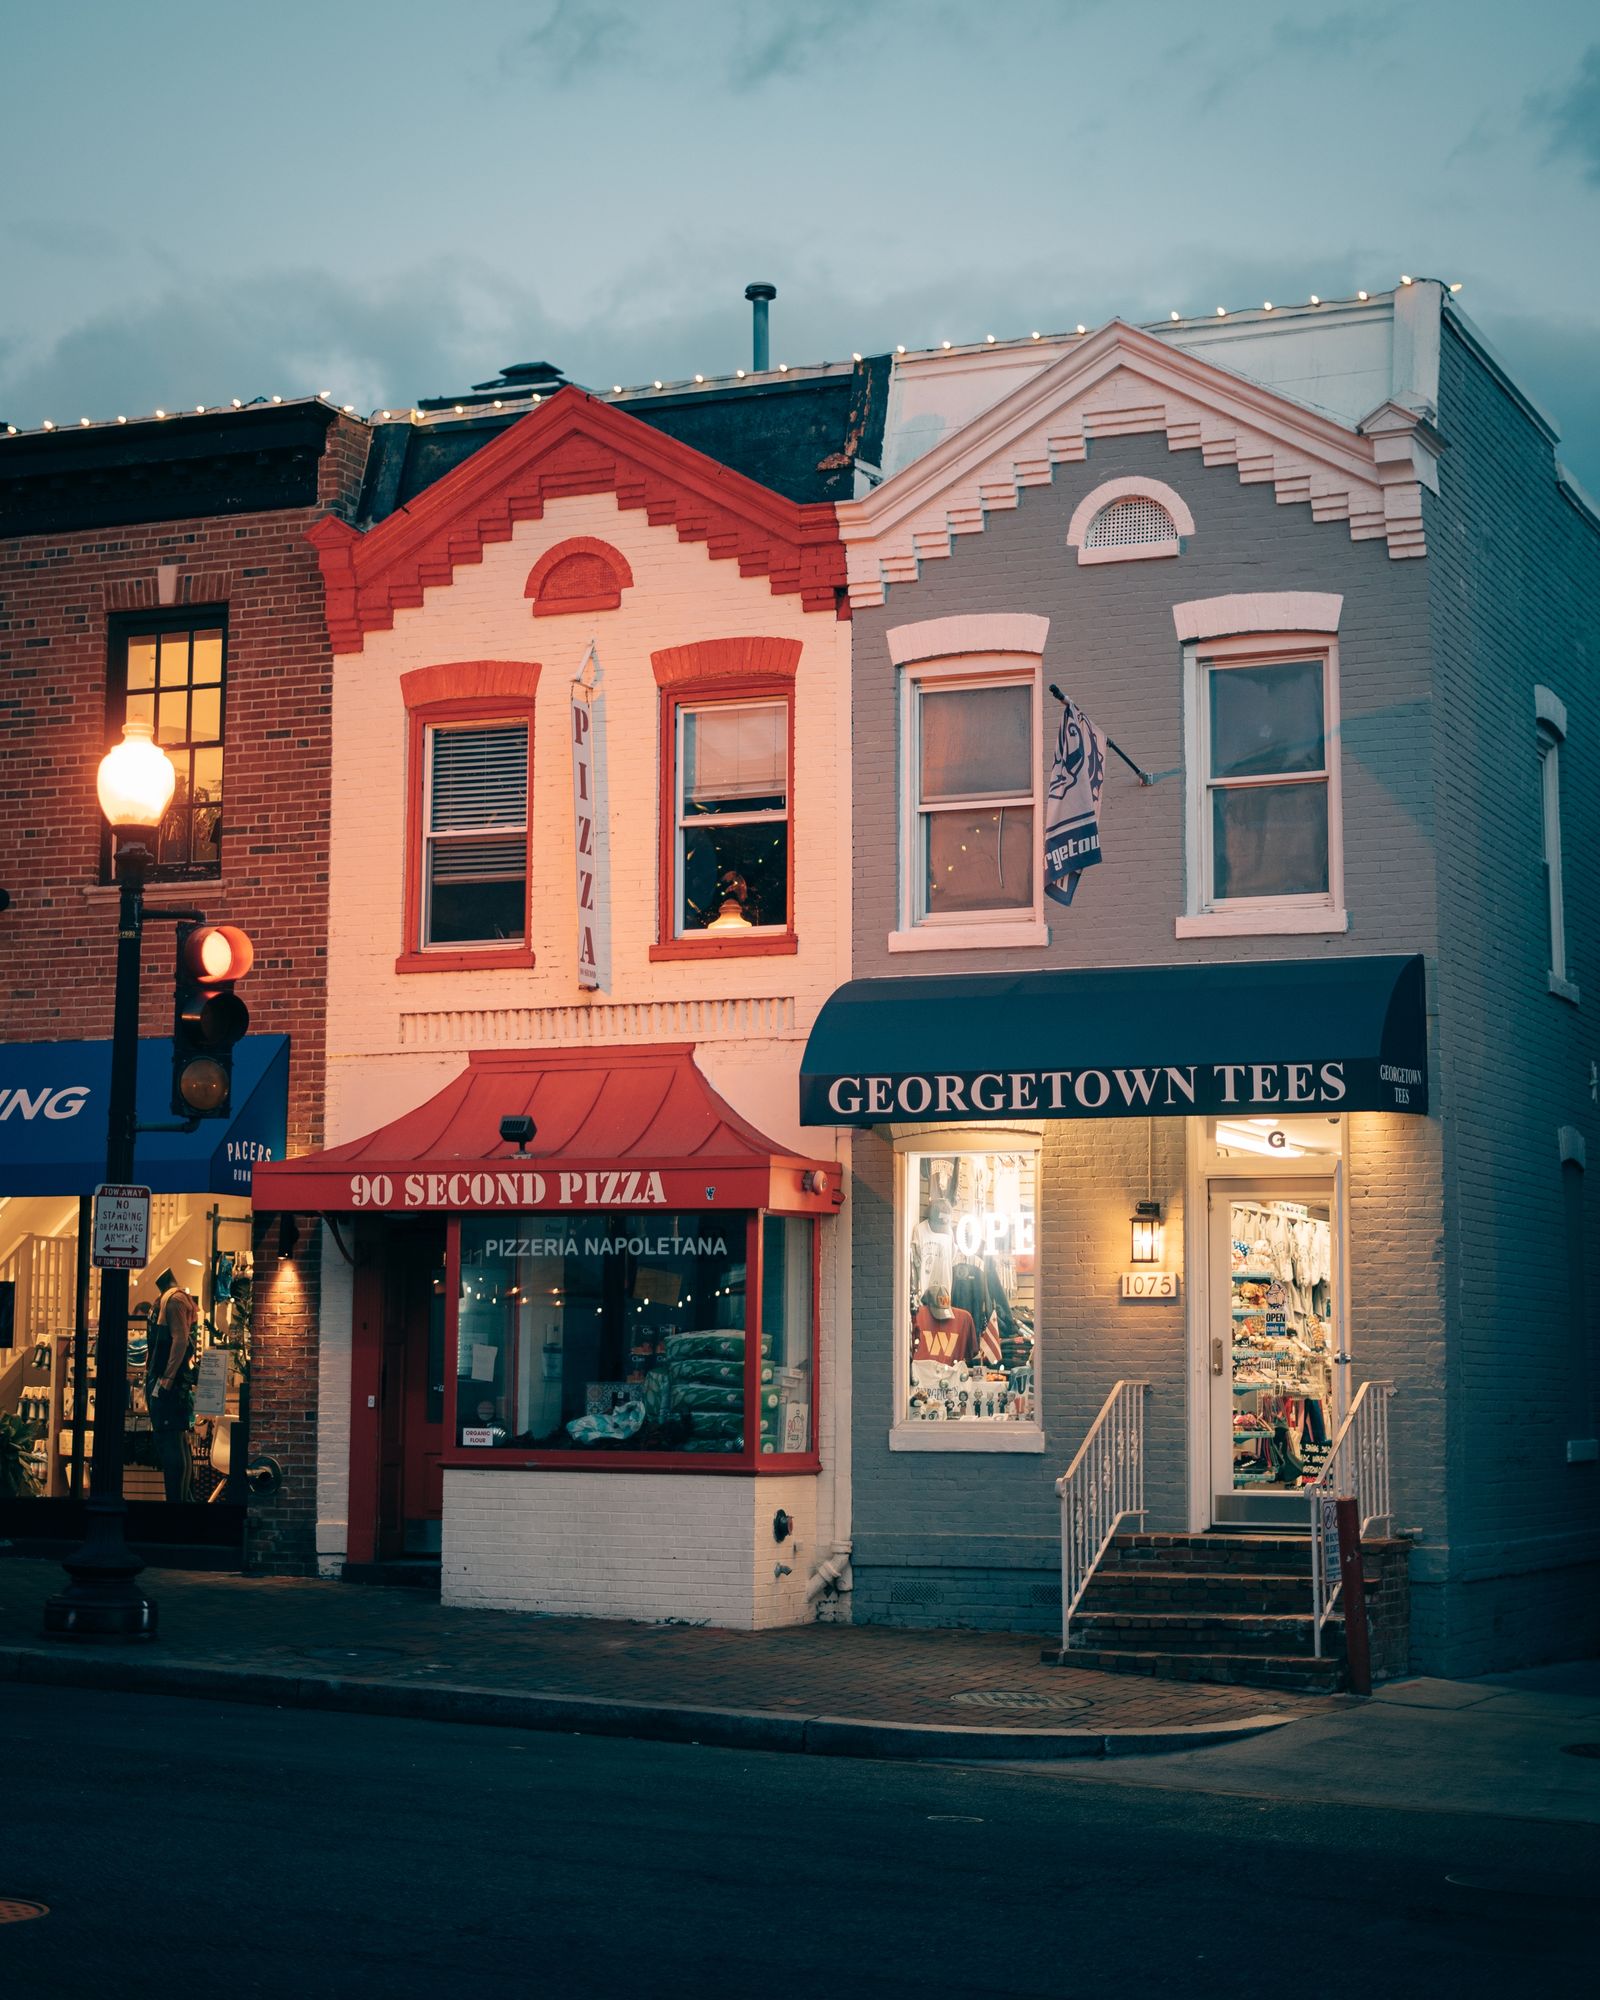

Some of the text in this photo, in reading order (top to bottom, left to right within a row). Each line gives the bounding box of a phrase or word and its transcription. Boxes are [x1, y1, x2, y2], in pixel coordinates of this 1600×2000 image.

[573, 706, 596, 966] PIZZA
[1380, 1064, 1422, 1085] GEORGETOWN
[828, 1062, 1346, 1114] GEORGETOWN TEES
[1394, 1087, 1410, 1104] TEES
[1267, 1131, 1286, 1148] G
[227, 1141, 272, 1162] PACERS
[350, 1170, 667, 1206] 90 SECOND PIZZA
[116, 1200, 130, 1209] NO
[103, 1210, 142, 1221] STANDING
[108, 1223, 144, 1233] PARKING
[485, 1236, 728, 1257] PIZZERIA NAPOLETANA
[1126, 1276, 1172, 1296] 1075
[1265, 1313, 1286, 1323] OPEN
